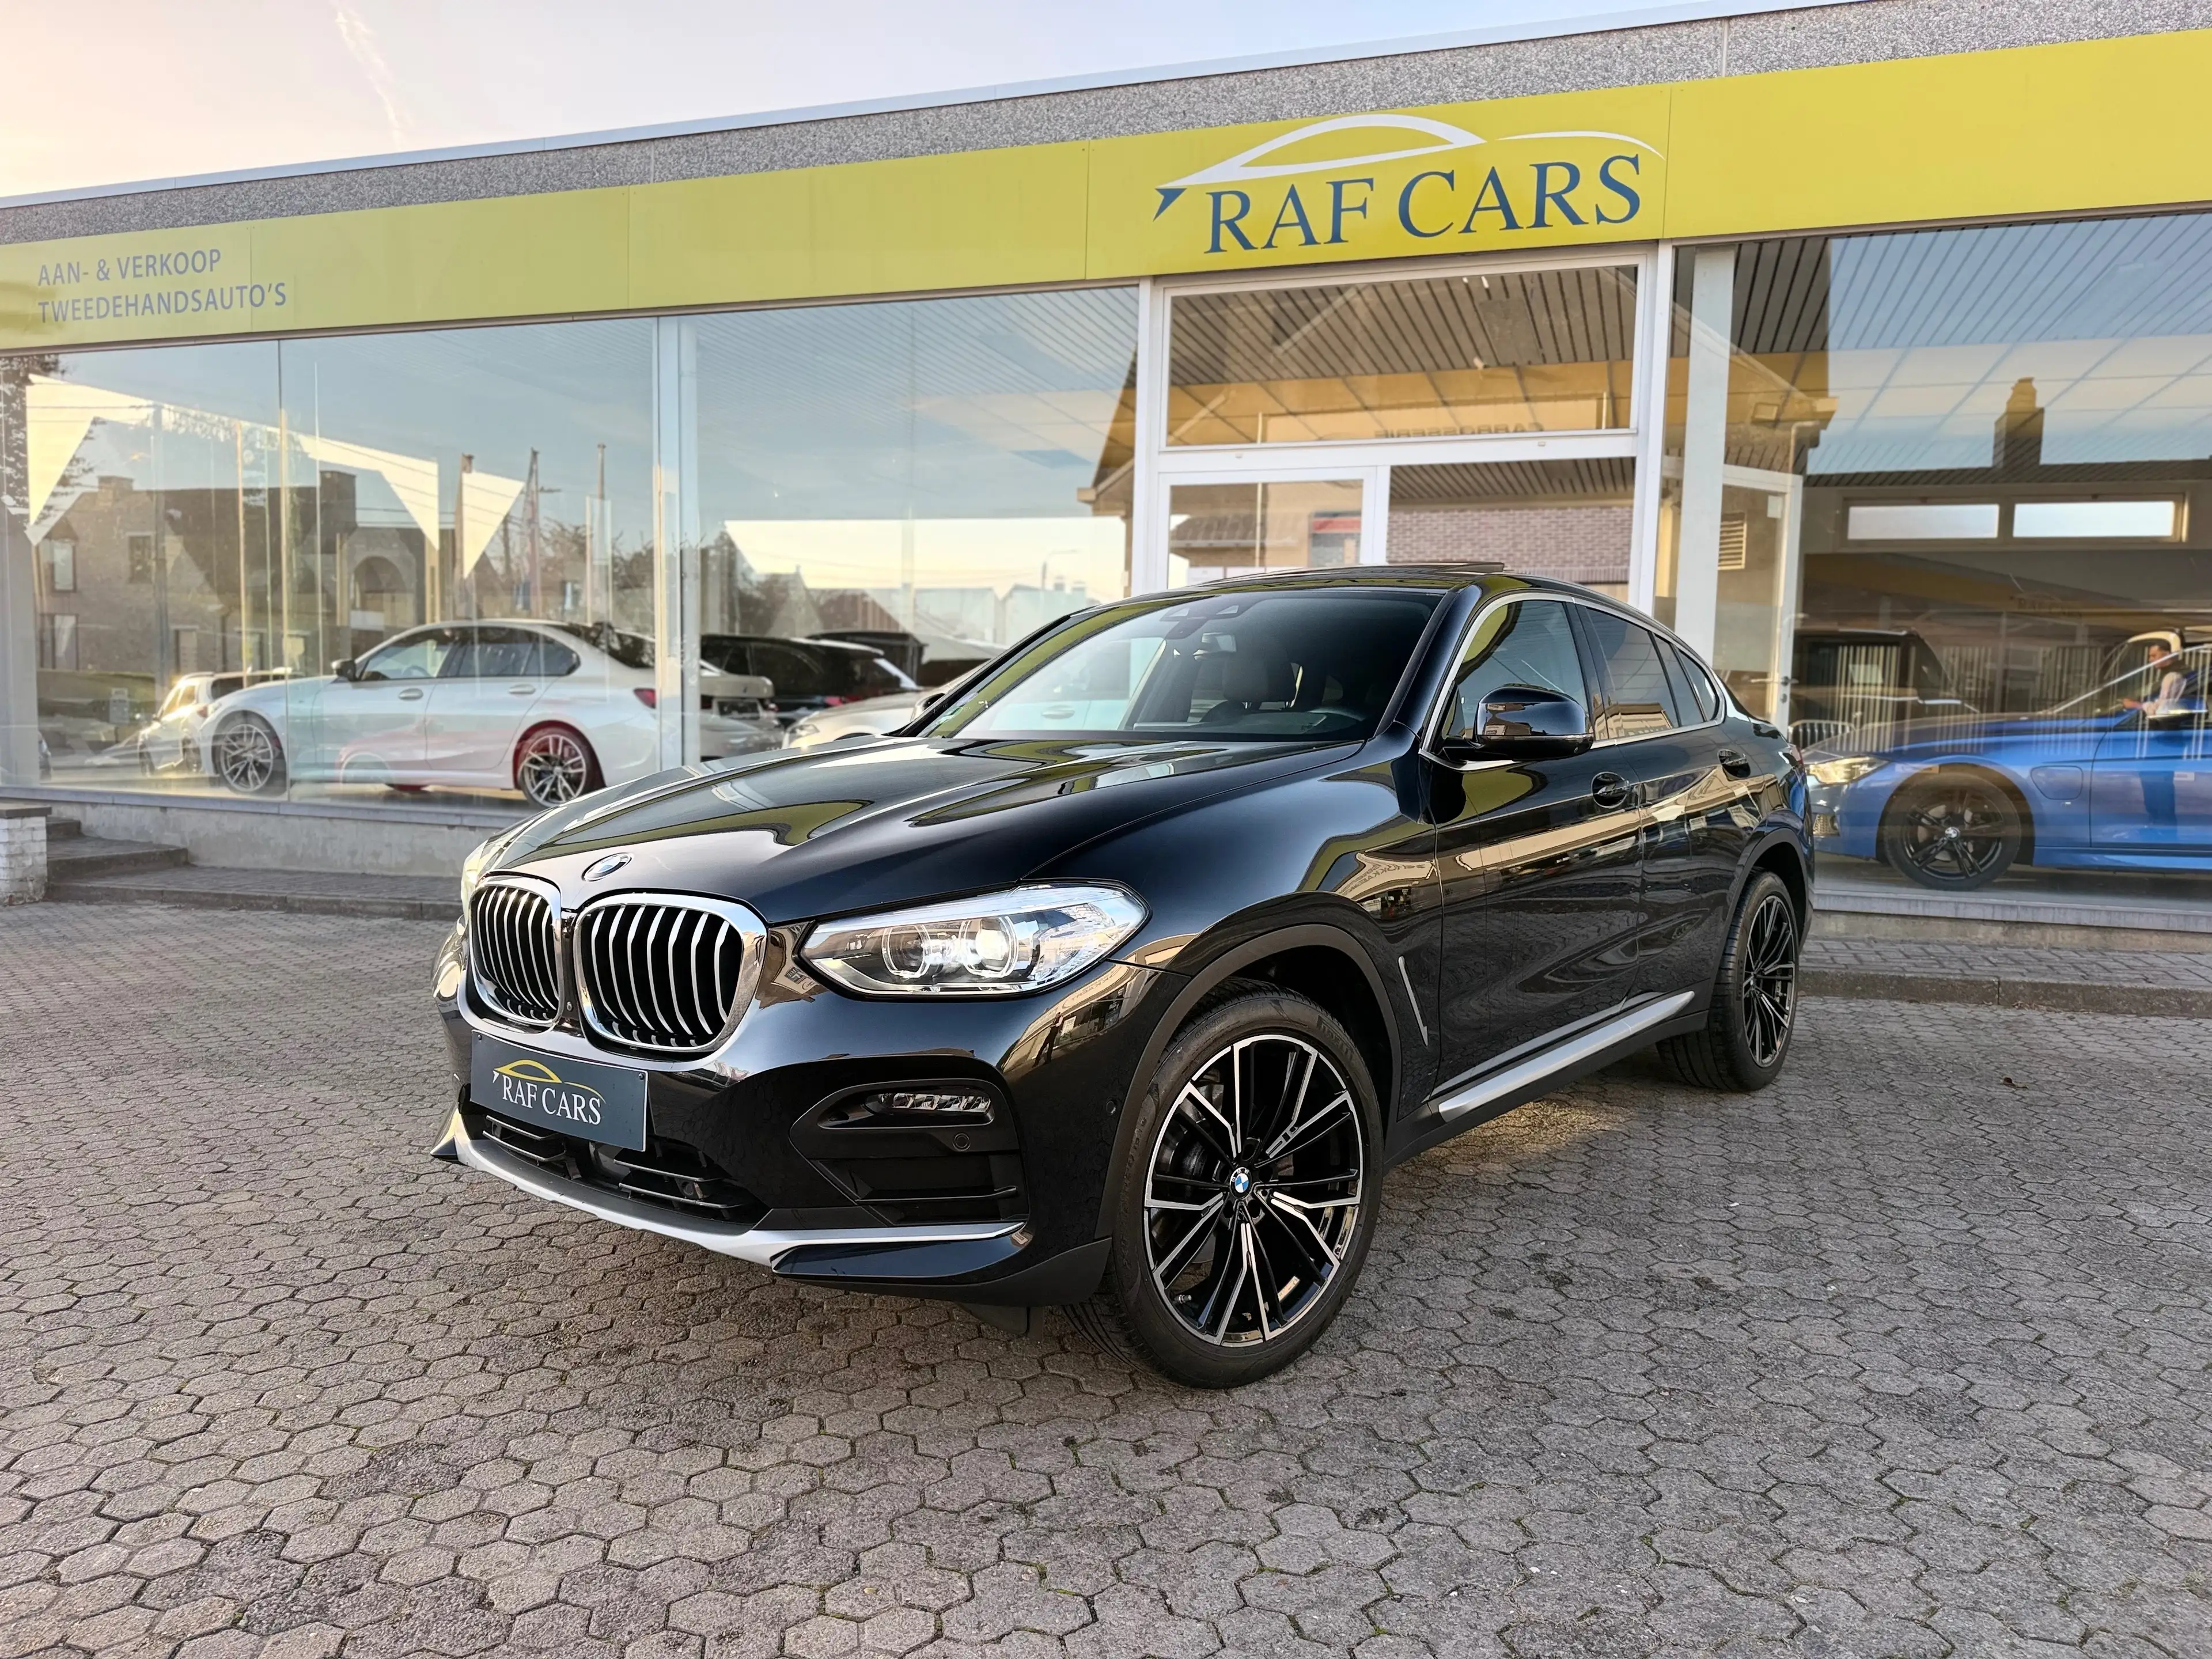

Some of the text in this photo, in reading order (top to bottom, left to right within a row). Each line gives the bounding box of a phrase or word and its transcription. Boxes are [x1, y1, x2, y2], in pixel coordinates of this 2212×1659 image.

[1204, 153, 1641, 254] RAF CARS
[37, 248, 221, 287] AAN- & VERKOOP
[502, 1074, 601, 1125] RAF CARS
